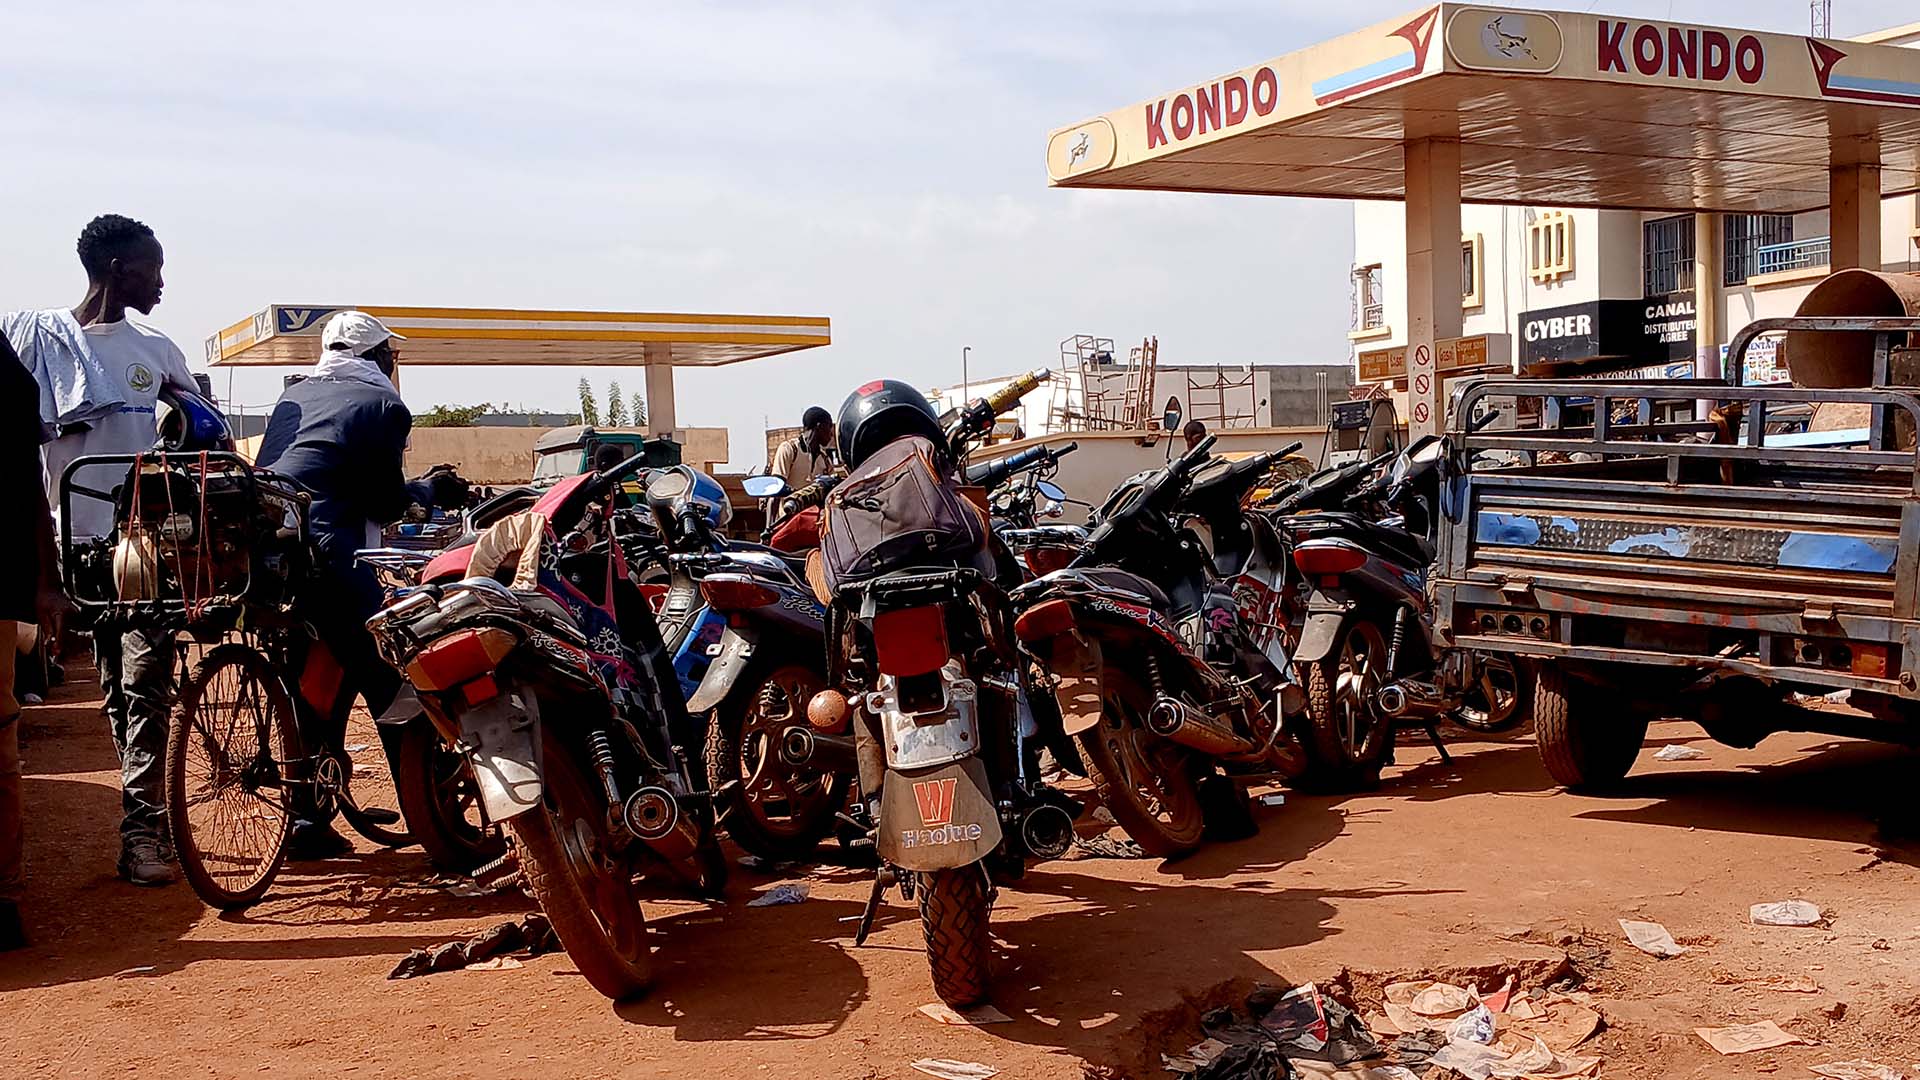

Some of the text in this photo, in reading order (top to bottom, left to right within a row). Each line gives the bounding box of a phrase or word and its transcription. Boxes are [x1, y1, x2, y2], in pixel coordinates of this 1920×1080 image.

[1598, 20, 1764, 84] KONDO
[1145, 66, 1278, 150] KONDO
[1645, 301, 1697, 319] CANAL
[1526, 314, 1592, 342] CYBER
[1644, 320, 1697, 334] DISTRIBUTEU
[902, 823, 982, 849] Haojue
